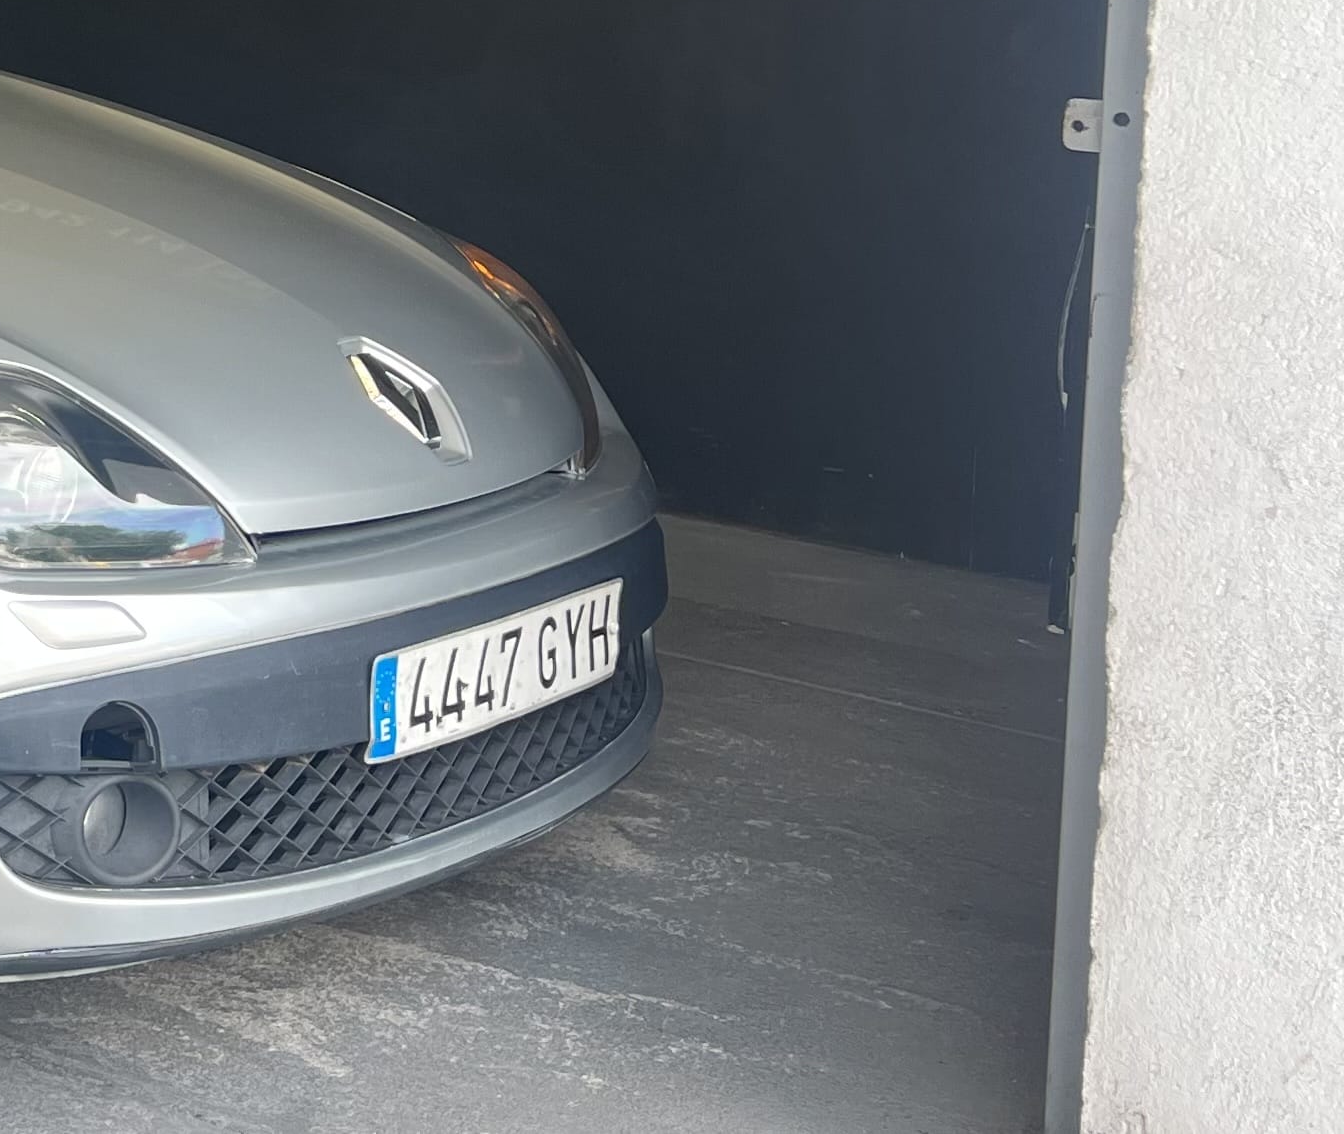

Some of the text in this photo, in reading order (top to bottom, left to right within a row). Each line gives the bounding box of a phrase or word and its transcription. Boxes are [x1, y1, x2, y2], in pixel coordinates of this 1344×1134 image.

[410, 594, 611, 734] 4447 GYH
[380, 718, 391, 743] E
